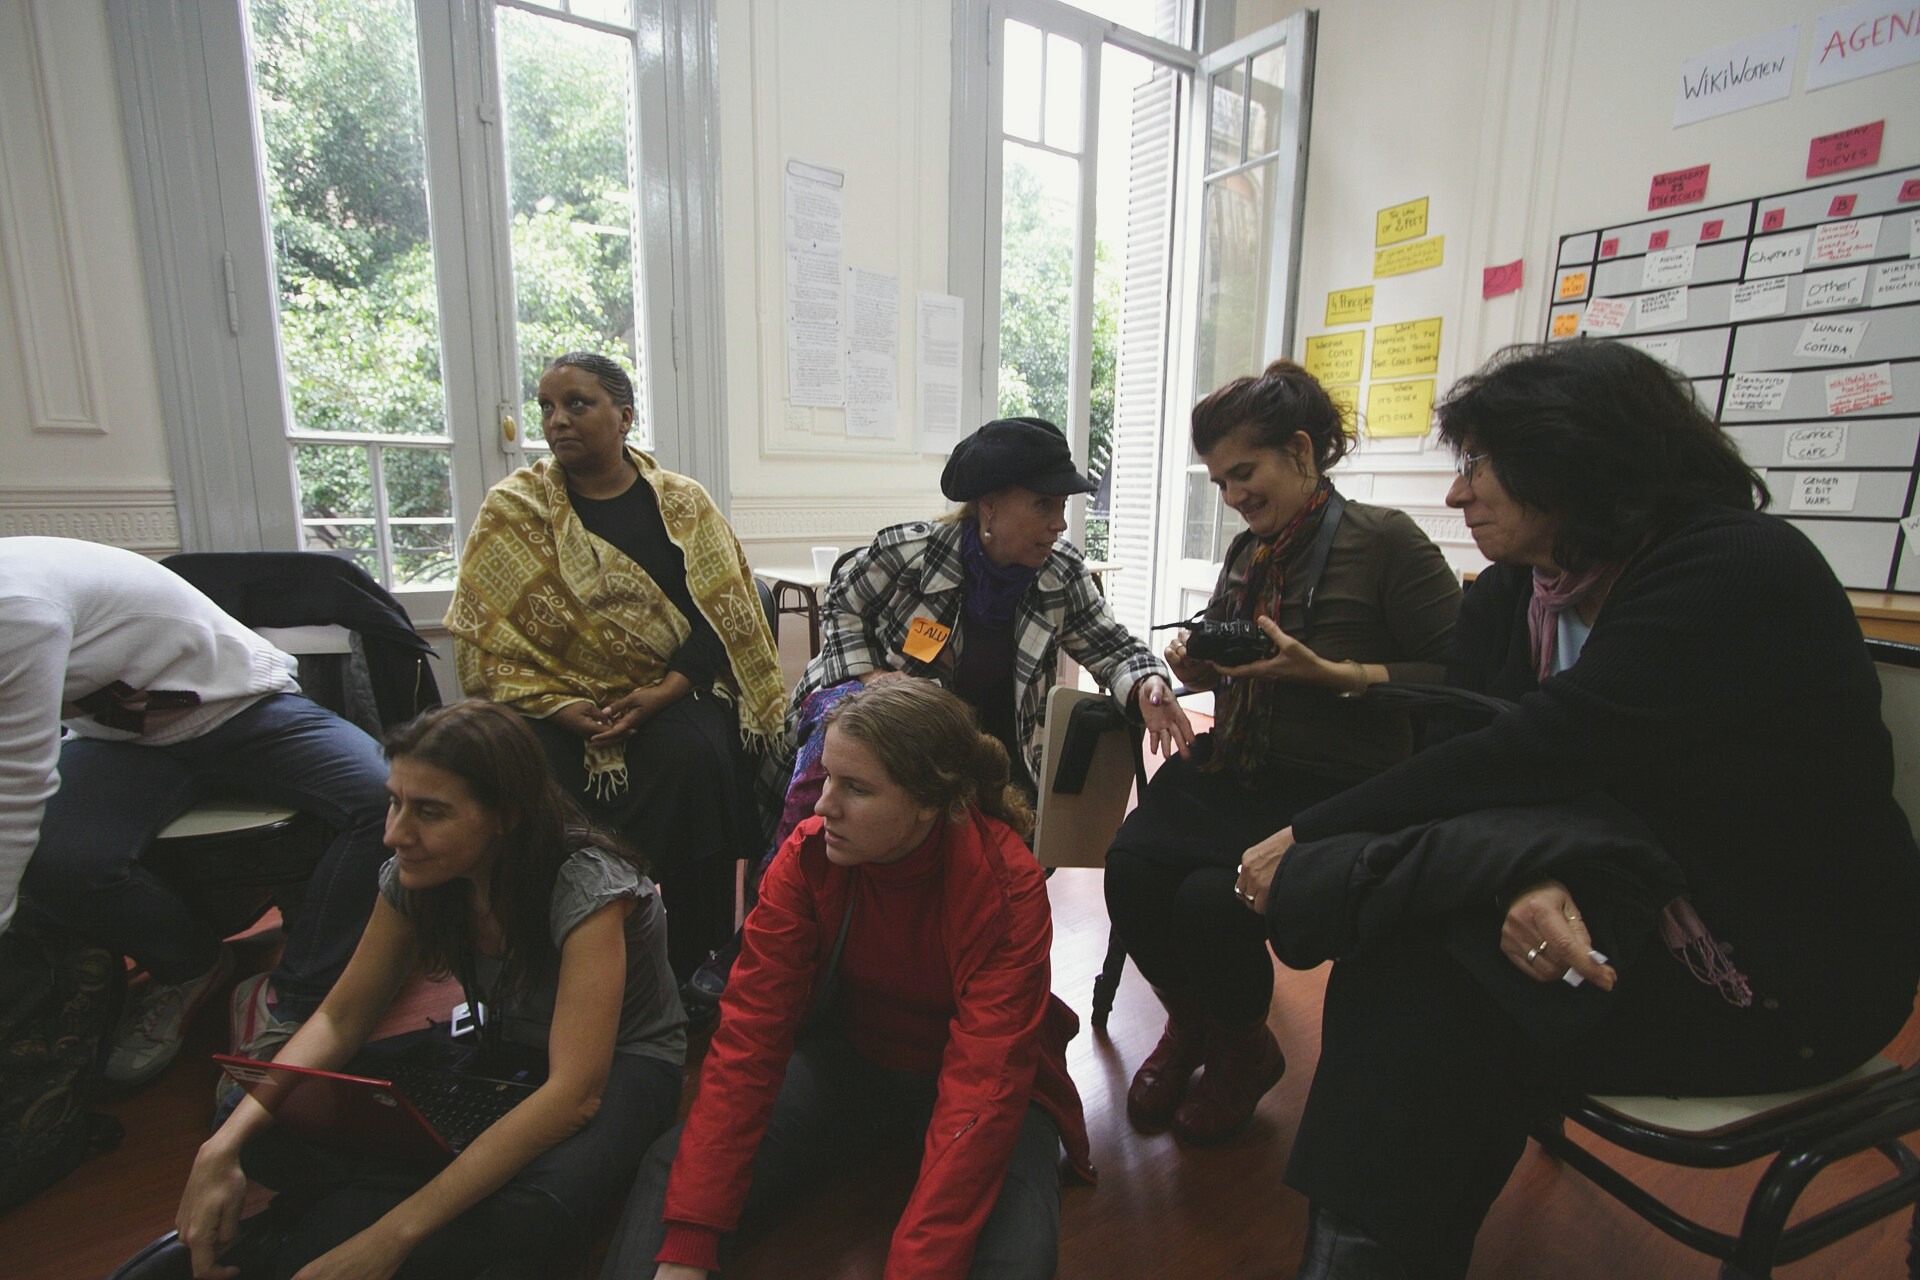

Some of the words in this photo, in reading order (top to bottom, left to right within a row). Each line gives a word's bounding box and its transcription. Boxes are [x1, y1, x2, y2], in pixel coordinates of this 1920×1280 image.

[1808, 277, 1857, 297] Other
[1812, 322, 1854, 334] LUNCH
[1804, 342, 1847, 354] COMIDA
[1805, 487, 1832, 495] EDIT
[1804, 497, 1831, 505] WARS
